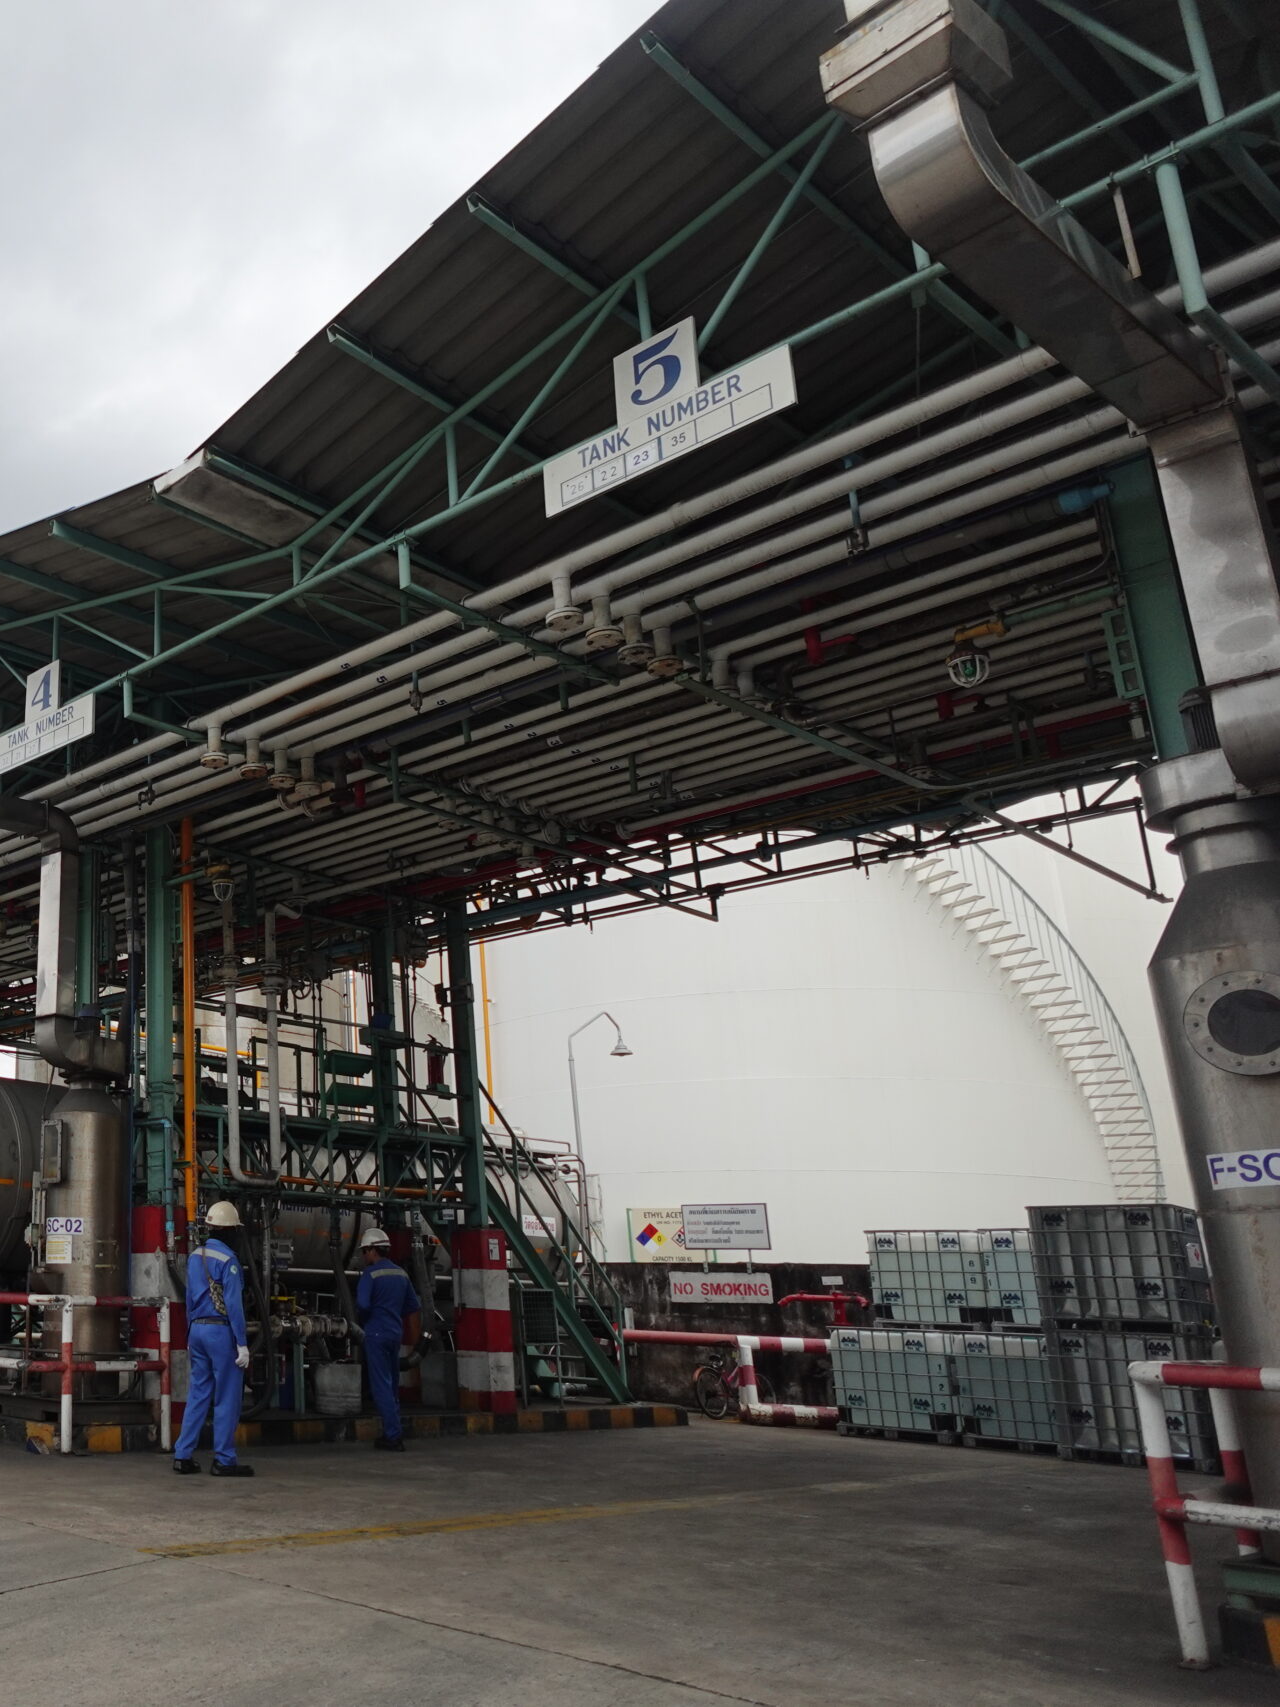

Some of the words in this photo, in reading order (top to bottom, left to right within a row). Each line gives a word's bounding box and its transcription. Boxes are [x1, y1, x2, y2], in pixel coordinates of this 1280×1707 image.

[630, 328, 682, 405] 5
[578, 427, 630, 468] TANK
[646, 374, 742, 436] NUMBER
[600, 466, 617, 481] 22
[633, 450, 650, 466] 23
[671, 432, 686, 447] 35
[31, 669, 52, 711] 4
[8, 727, 29, 748] TANK
[35, 705, 74, 736] NUMBER
[47, 1218, 83, 1233] SC-02
[673, 1283, 694, 1296] NO
[701, 1282, 770, 1297] SMOKING
[937, 1363, 942, 1371] 1
[938, 1383, 945, 1391] 2
[941, 1403, 947, 1411] 3
